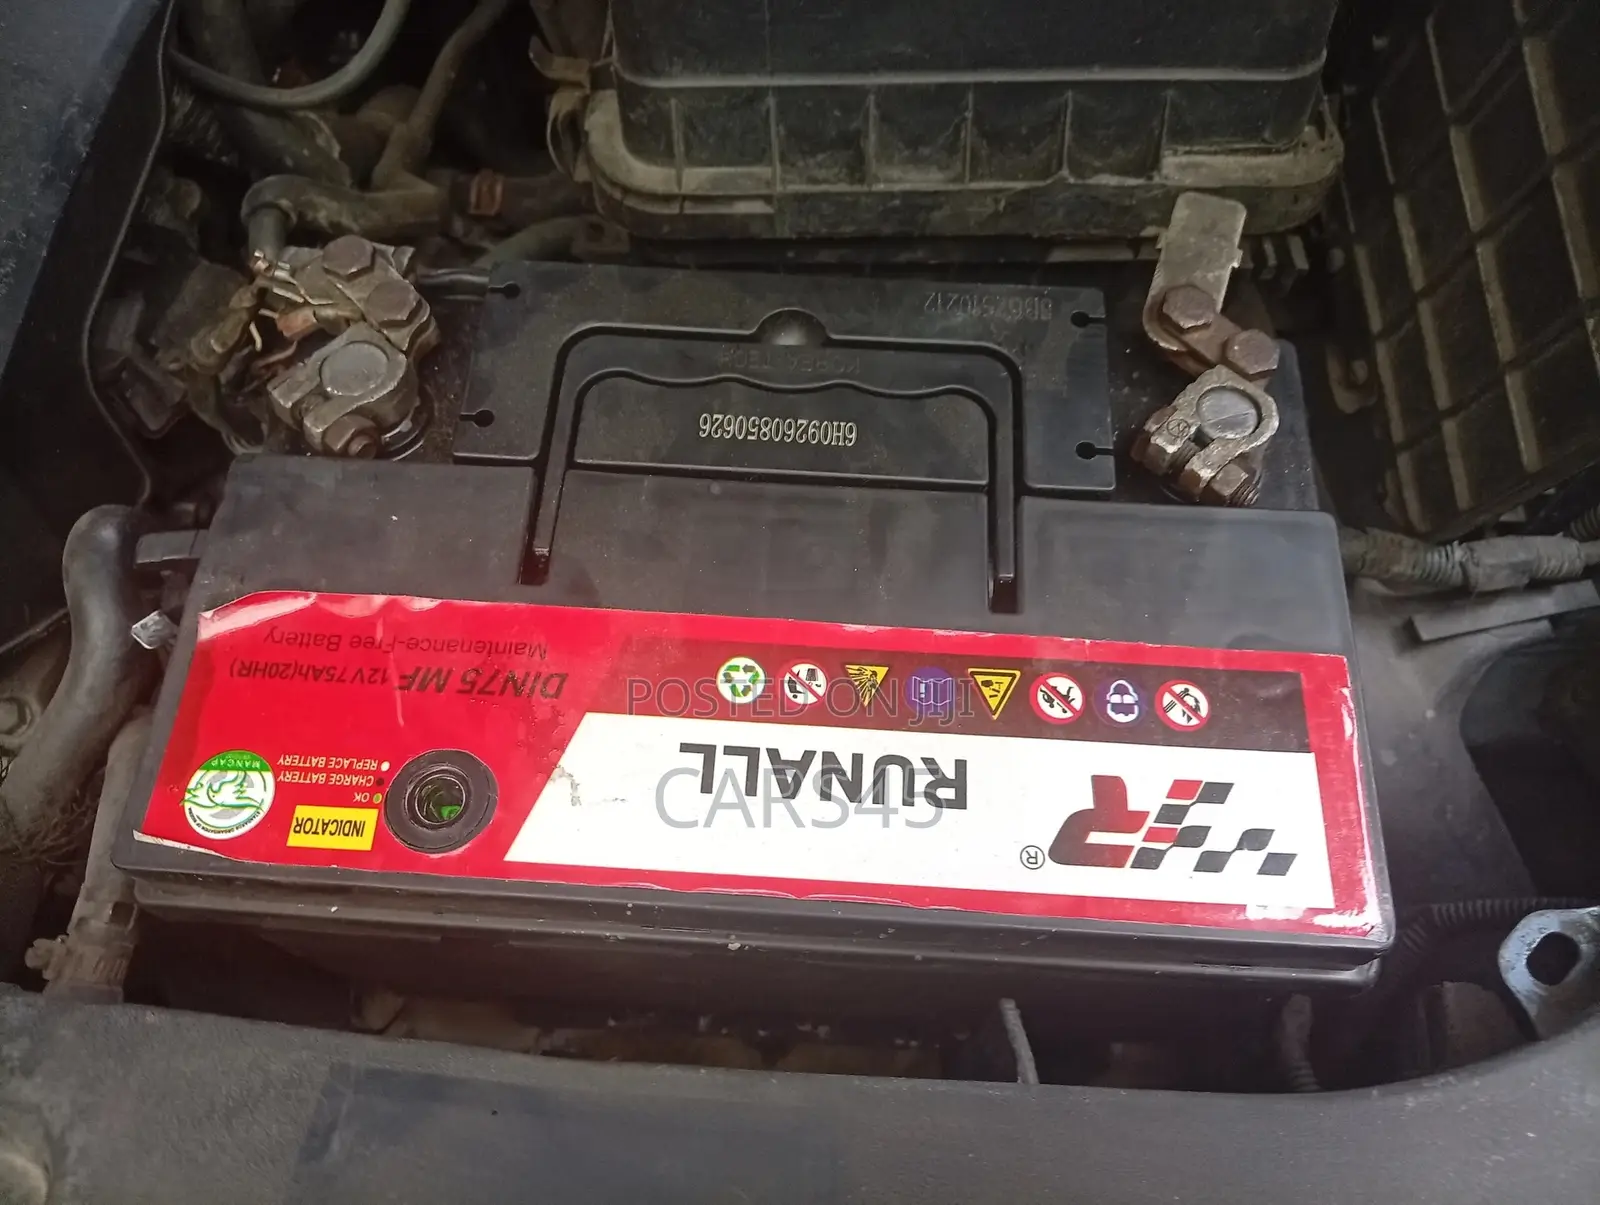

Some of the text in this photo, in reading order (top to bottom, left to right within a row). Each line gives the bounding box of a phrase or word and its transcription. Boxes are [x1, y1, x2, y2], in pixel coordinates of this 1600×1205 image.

[699, 413, 857, 446] 6H09260850626
[264, 625, 547, 661] Maintenance-Free Battery
[229, 657, 569, 700] DIN75 MF 12V 75Ah(20HR)
[211, 758, 261, 770] MANCAP
[277, 753, 379, 771] REPLACE BATTERY
[277, 770, 375, 787] CHARGE BATTERY
[679, 742, 967, 810] RUNALL
[353, 792, 370, 804] OK
[292, 815, 366, 838] INDICATOR
